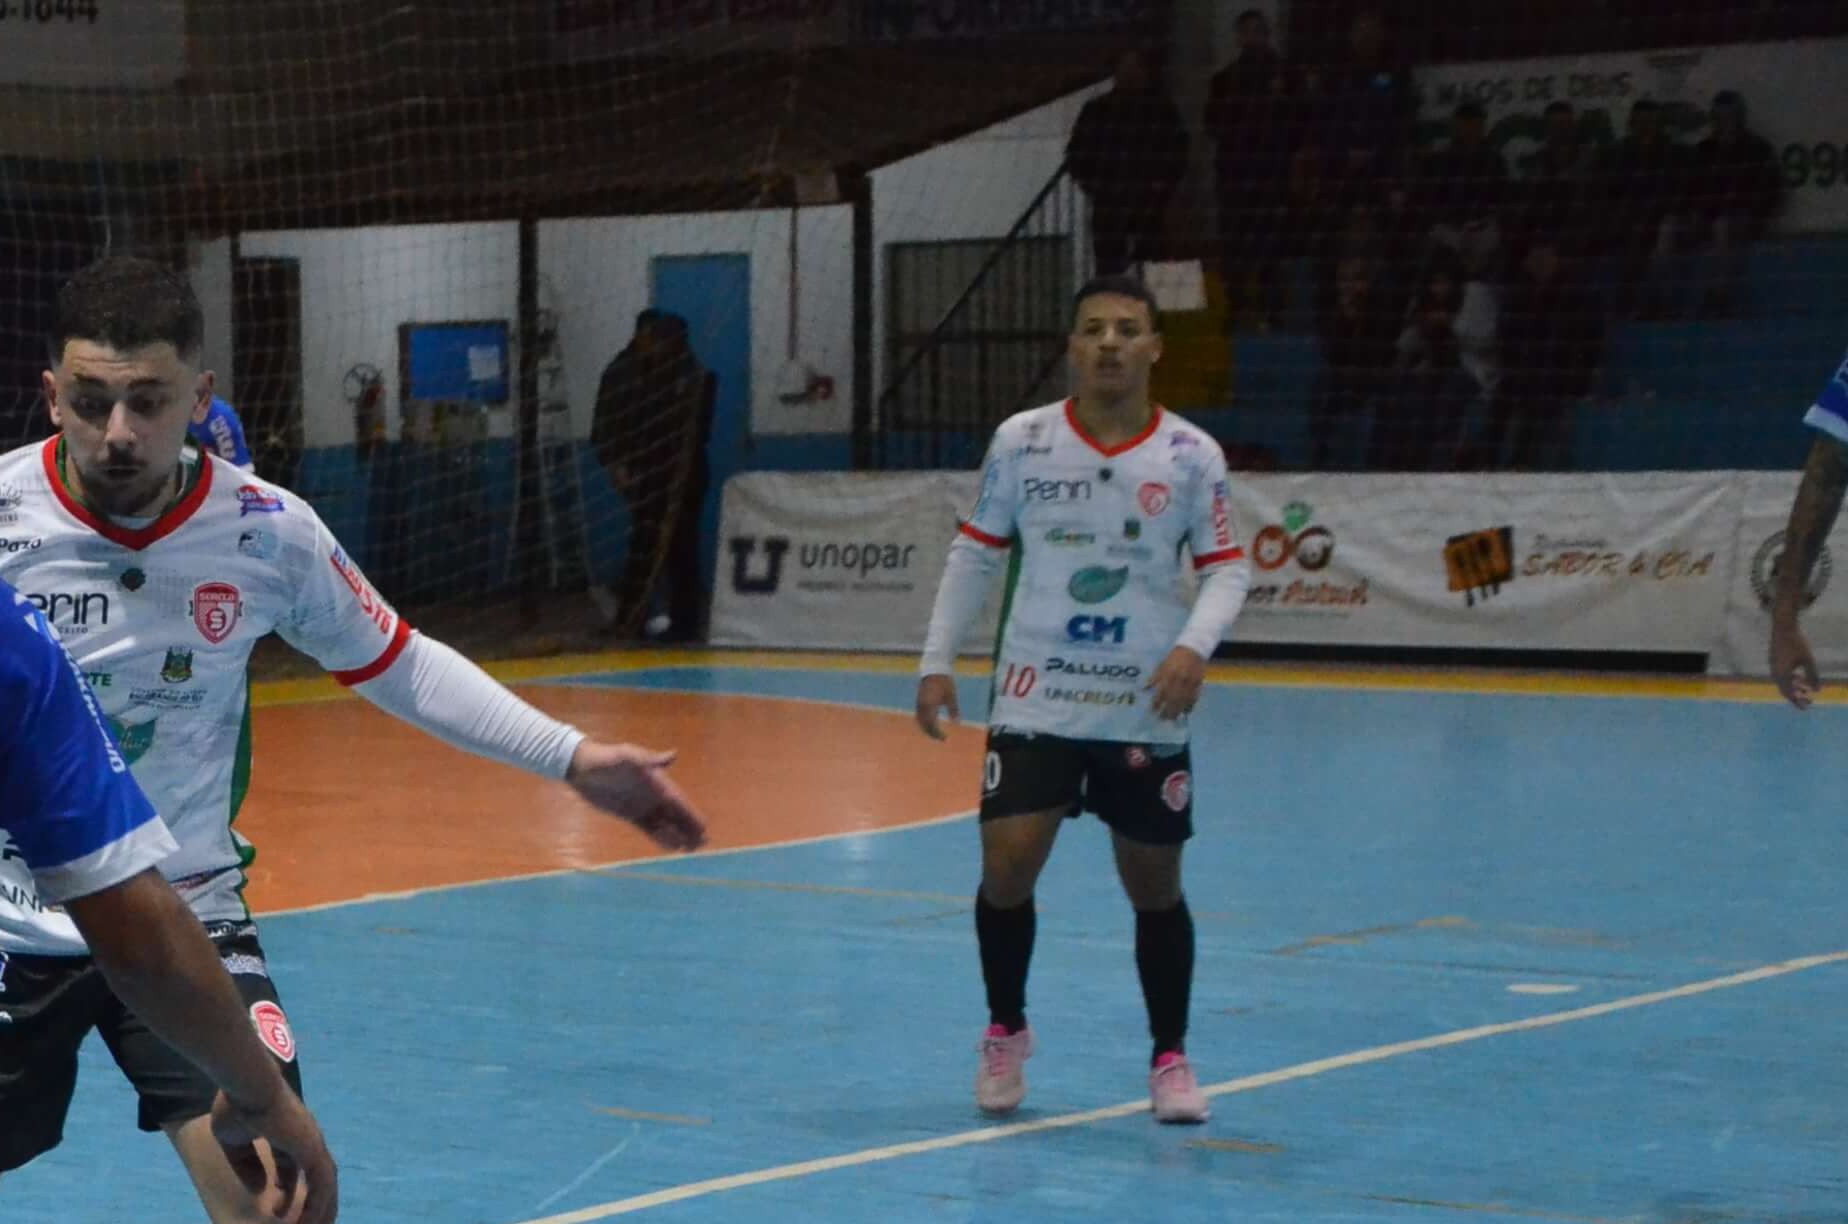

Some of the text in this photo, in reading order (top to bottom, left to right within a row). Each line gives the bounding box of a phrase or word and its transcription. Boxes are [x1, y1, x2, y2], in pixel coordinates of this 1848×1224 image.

[1782, 142, 1848, 190] 99
[800, 542, 916, 578] unopar
[1066, 614, 1130, 644] CM
[1002, 662, 1037, 699] 10
